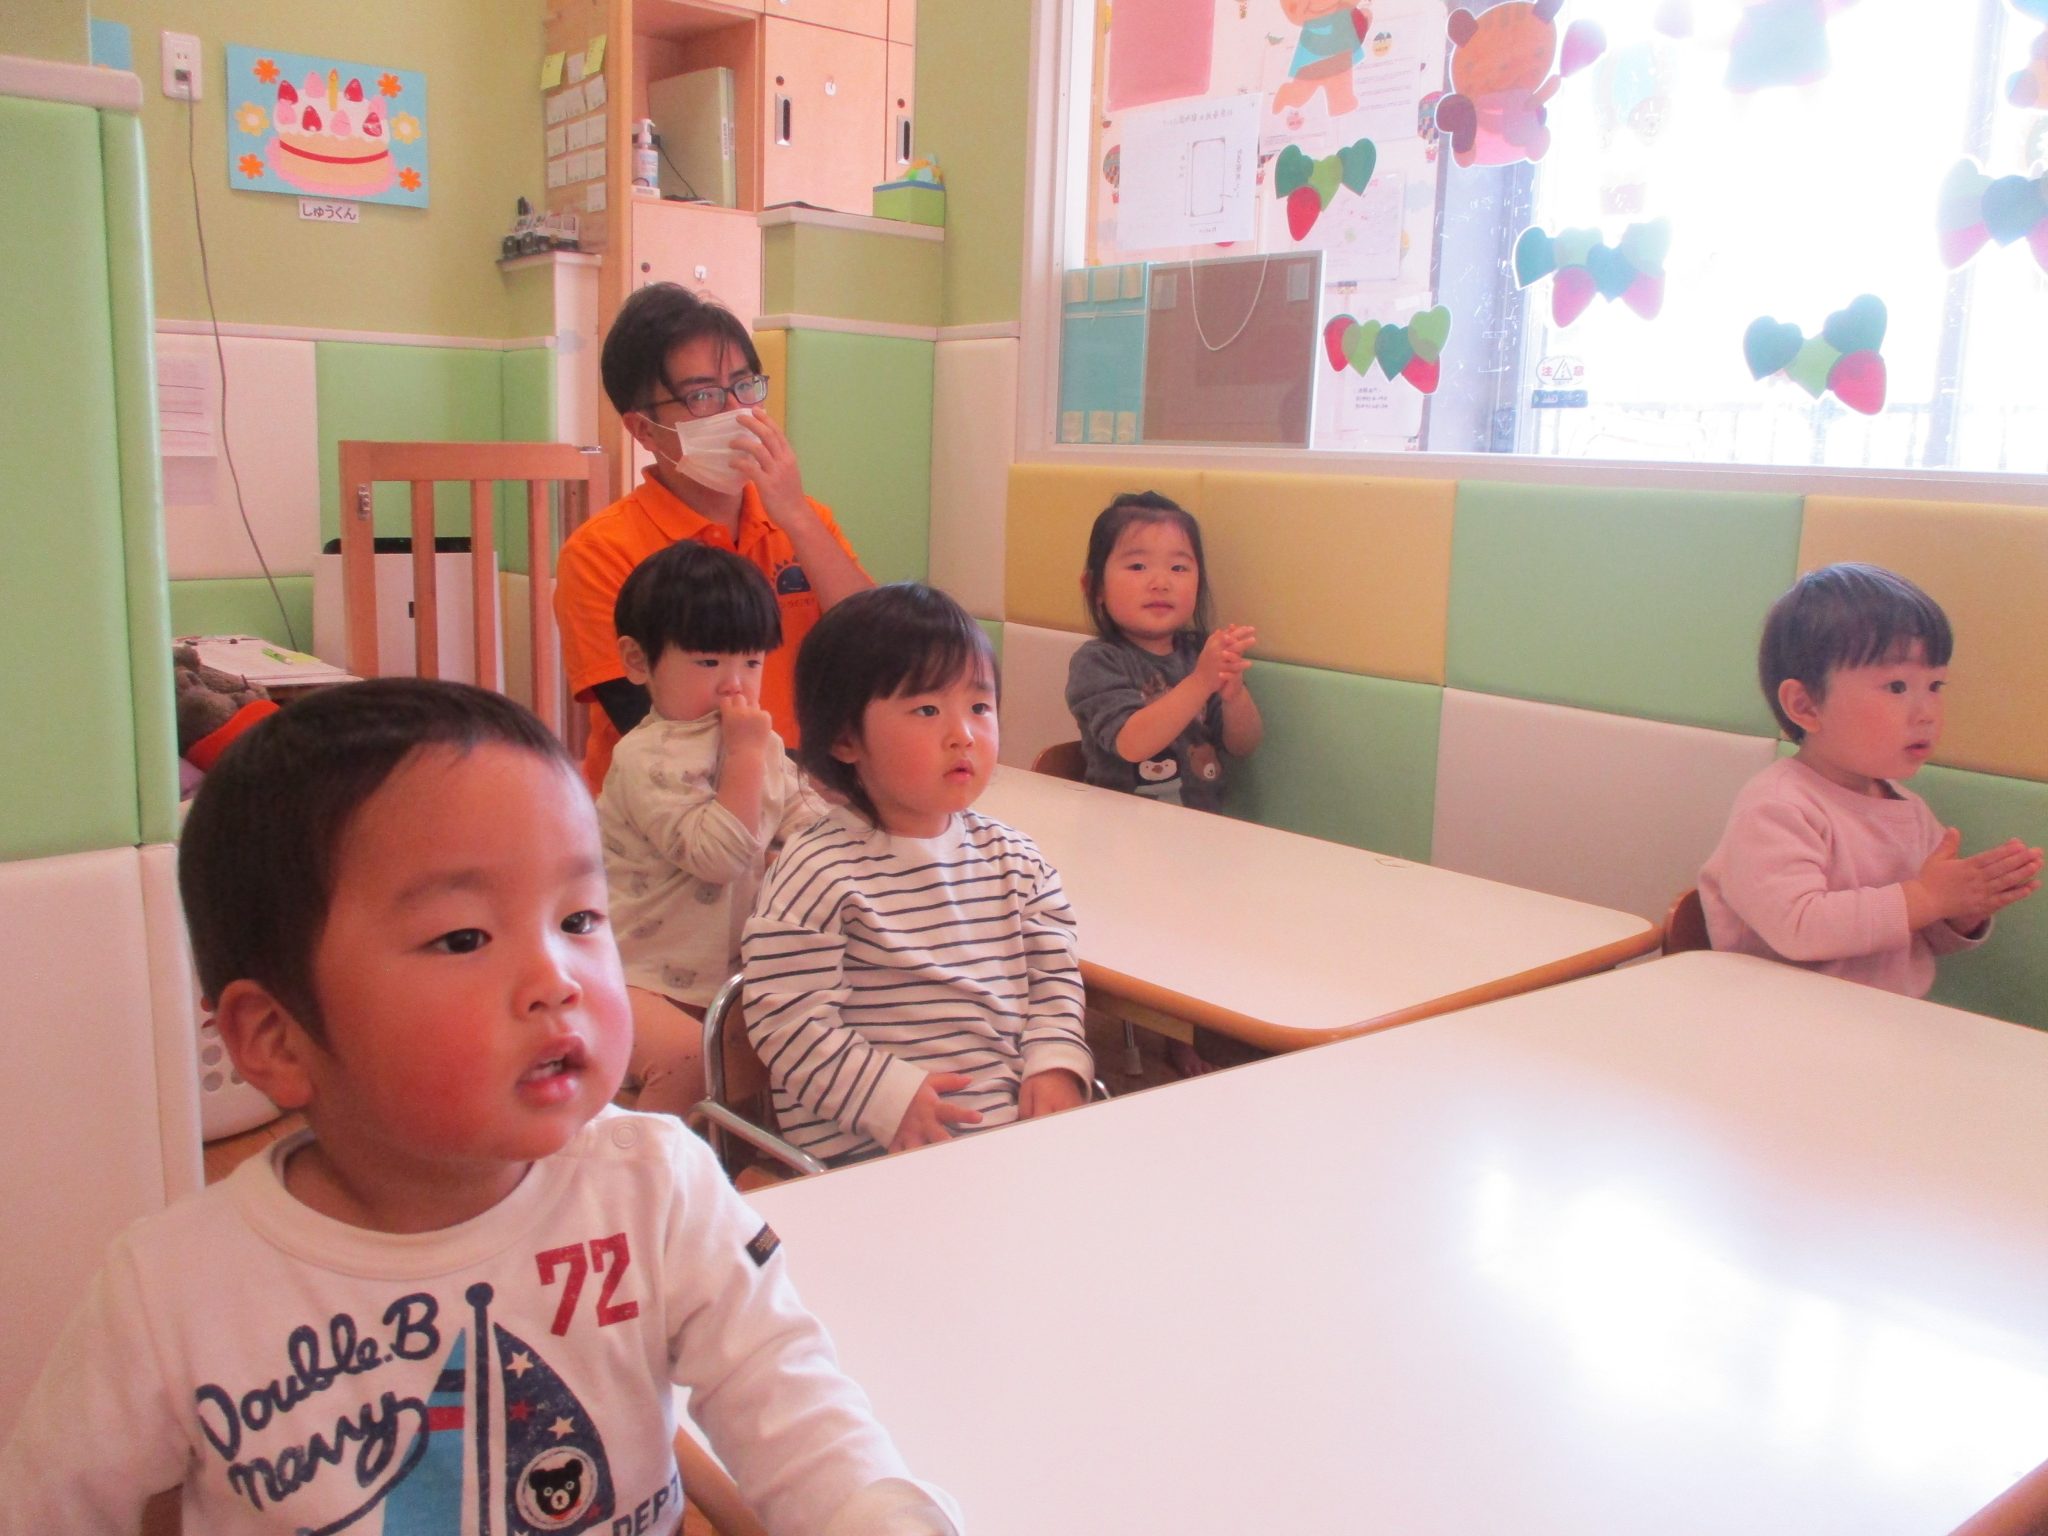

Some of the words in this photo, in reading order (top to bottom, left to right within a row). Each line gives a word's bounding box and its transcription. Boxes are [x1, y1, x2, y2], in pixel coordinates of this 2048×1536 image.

[302, 203, 356, 220] しゅうくん
[535, 1232, 639, 1337] 72
